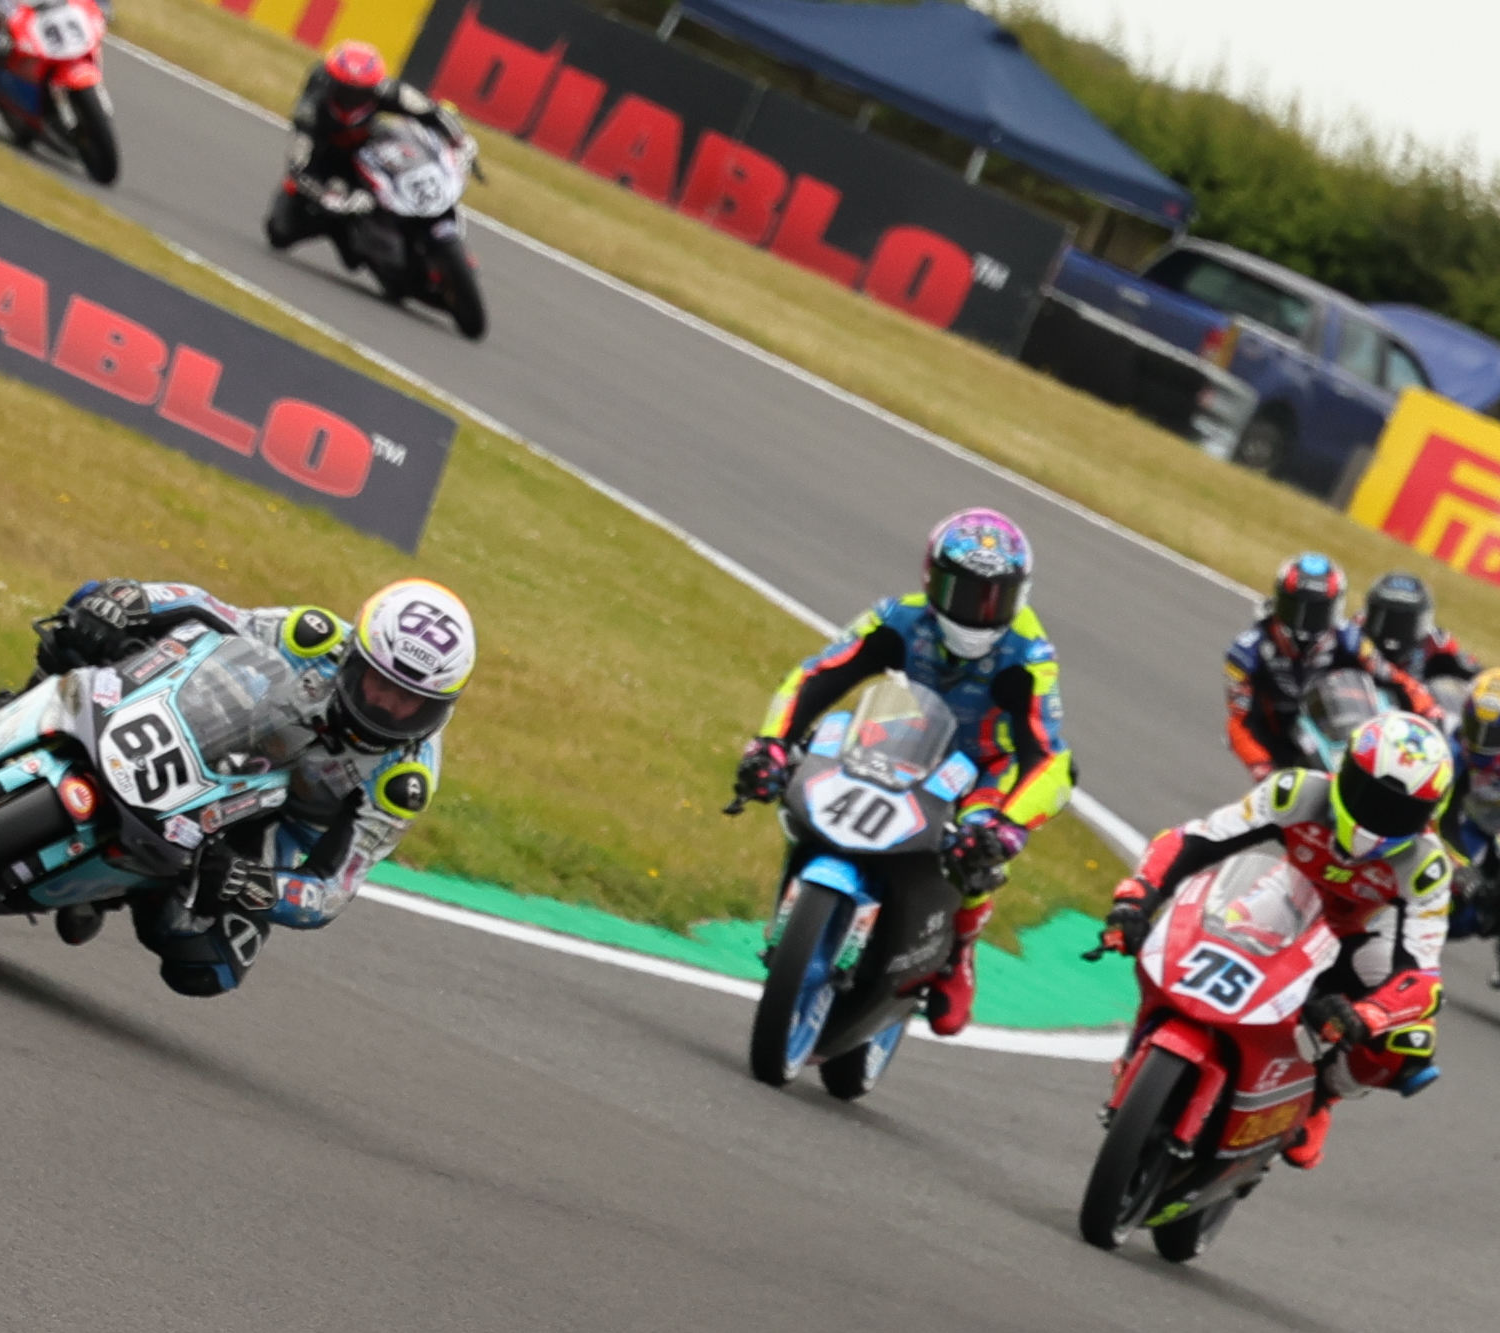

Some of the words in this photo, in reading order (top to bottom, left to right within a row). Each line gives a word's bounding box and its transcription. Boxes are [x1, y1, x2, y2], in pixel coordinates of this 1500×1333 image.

[428, 0, 975, 330] DIABLO
[972, 251, 1010, 290] TM
[372, 432, 407, 467] TM
[397, 600, 463, 656] 65
[401, 640, 437, 667] SHOEI
[109, 713, 189, 804] 65
[822, 785, 897, 841] 40
[1179, 948, 1256, 1007] 75
